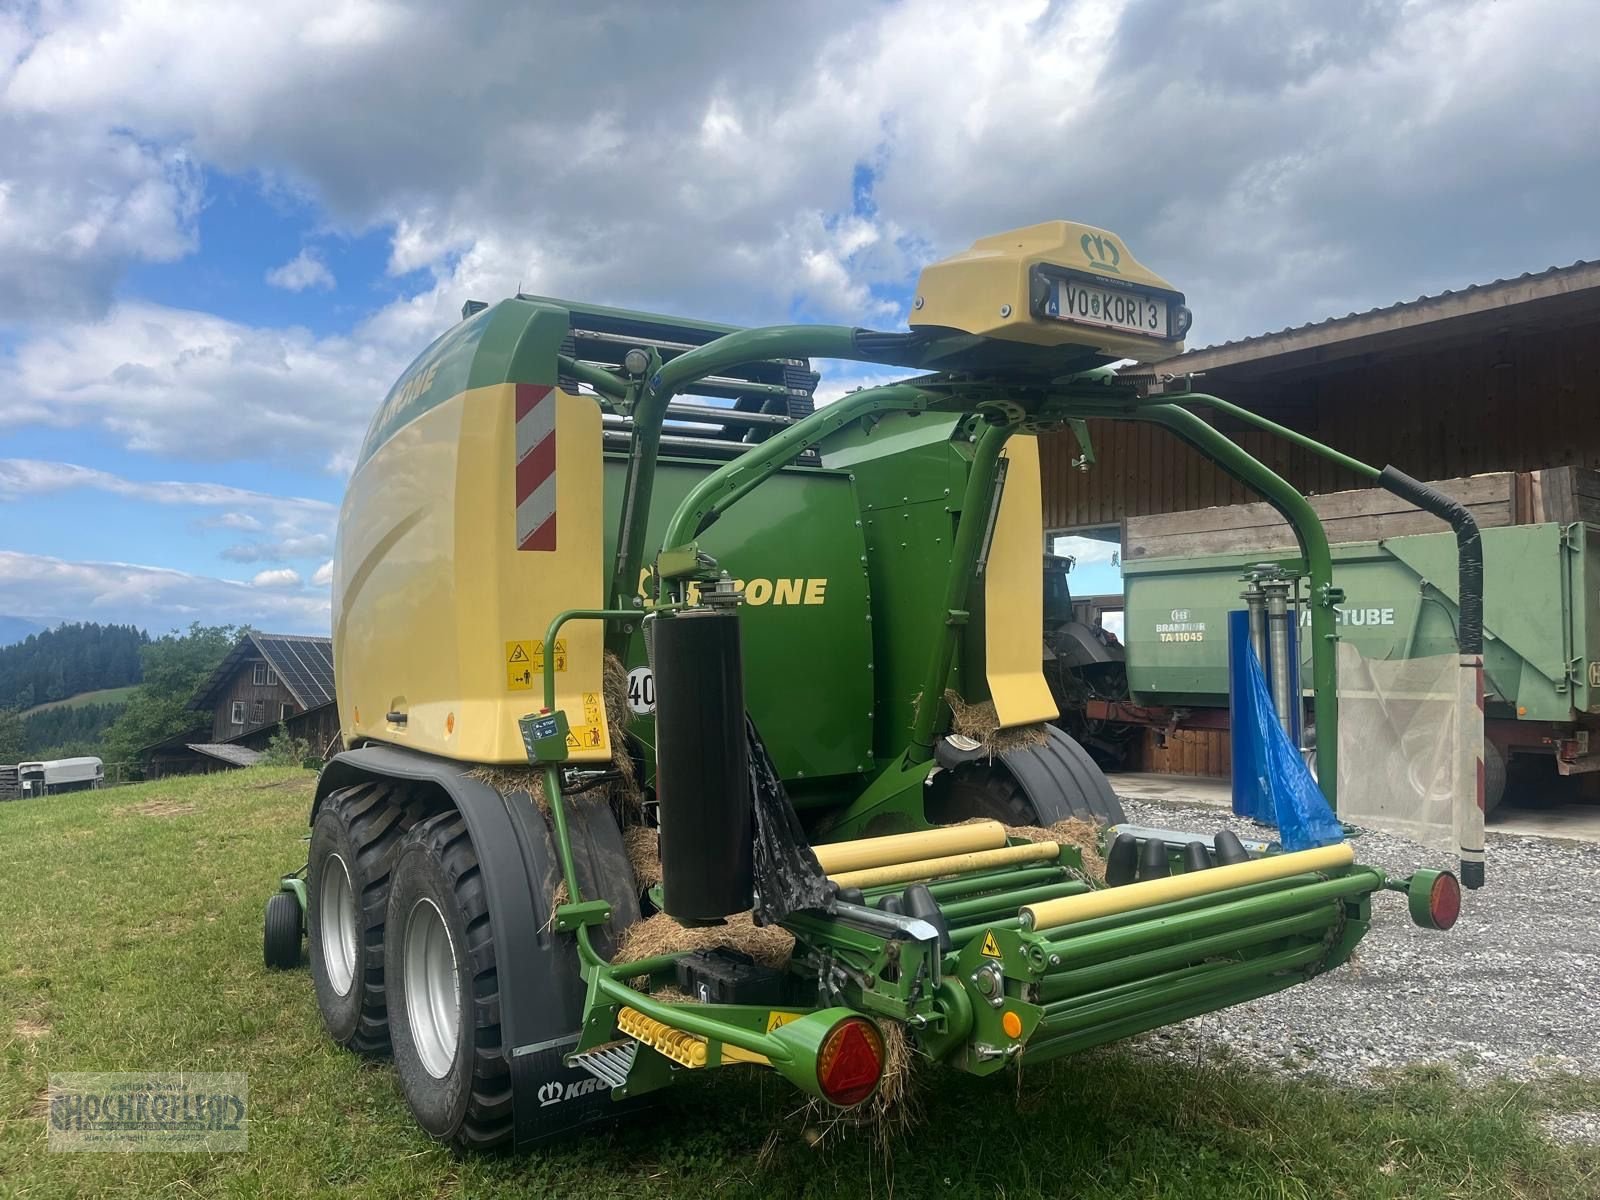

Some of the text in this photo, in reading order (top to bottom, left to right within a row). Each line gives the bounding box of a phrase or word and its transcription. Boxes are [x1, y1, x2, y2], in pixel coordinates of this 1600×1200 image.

[1066, 286, 1158, 329] VO KORI 3
[628, 675, 655, 705] 40
